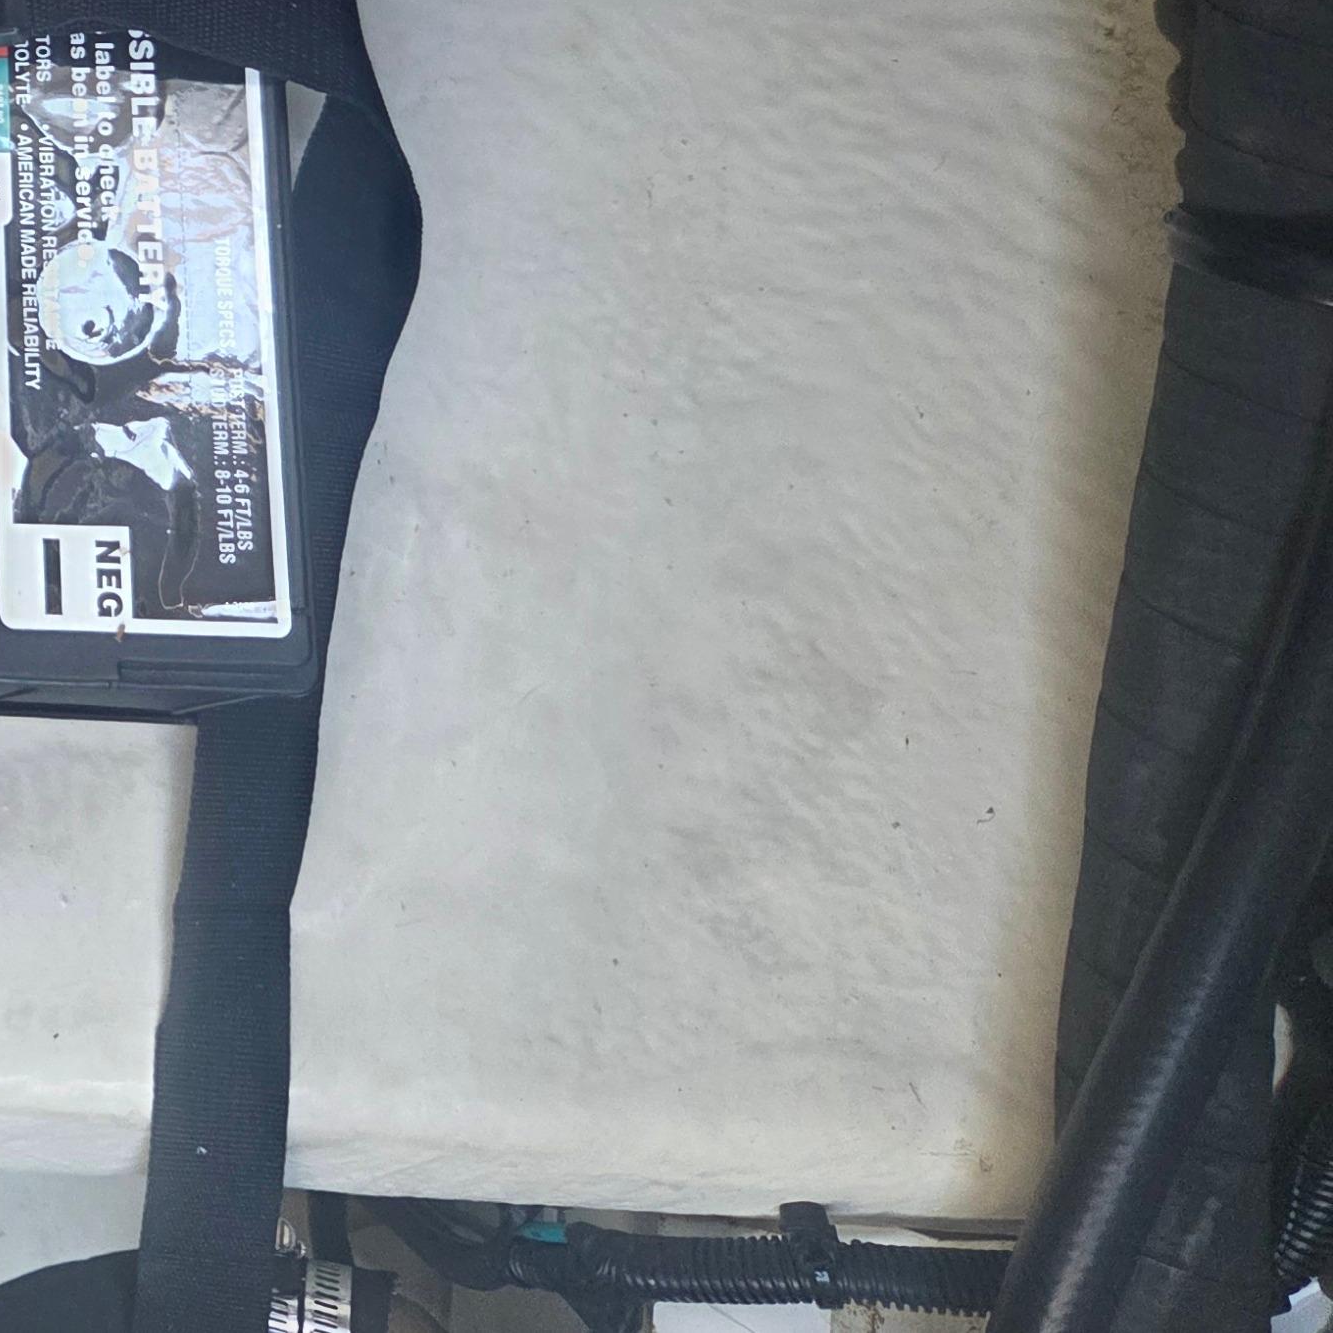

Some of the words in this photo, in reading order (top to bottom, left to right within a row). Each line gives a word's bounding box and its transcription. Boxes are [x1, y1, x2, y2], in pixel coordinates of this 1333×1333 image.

[14, 133, 35, 213] AMERICAN
[18, 213, 37, 271] MADE
[20, 281, 41, 390] RELIABILITY
[215, 507, 236, 566] FT/LBS
[233, 496, 253, 553] FT/LBS
[93, 539, 123, 618] NEG
